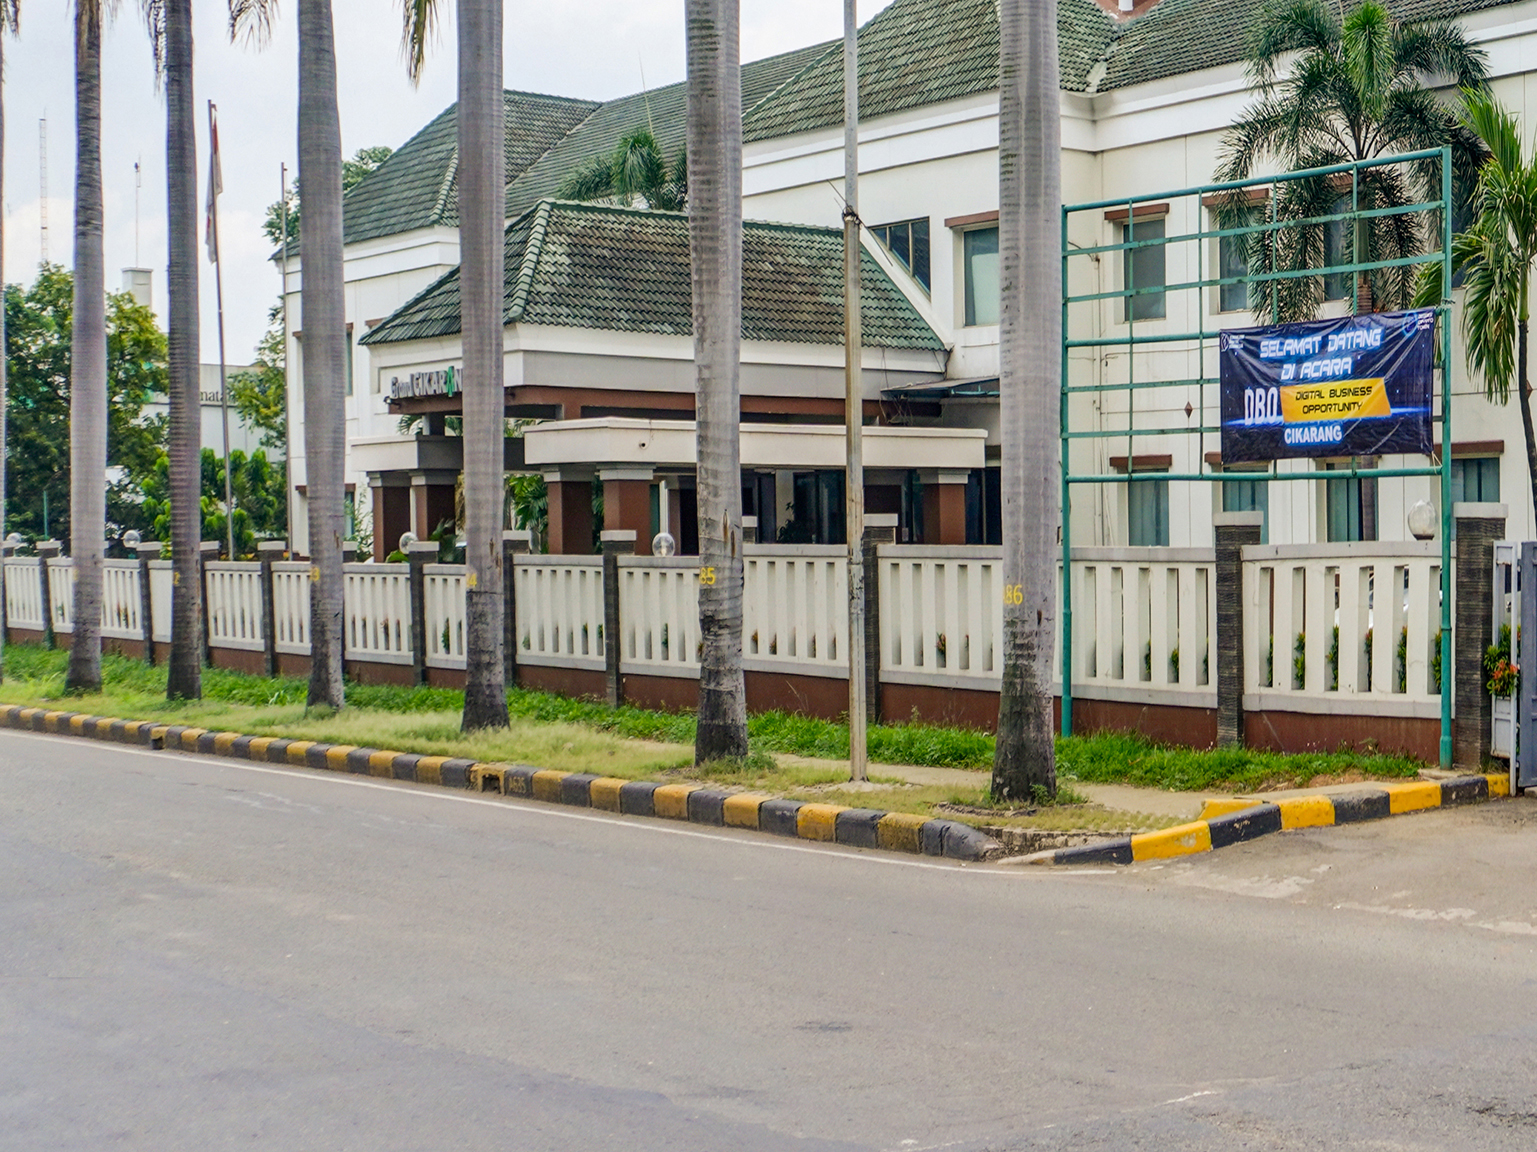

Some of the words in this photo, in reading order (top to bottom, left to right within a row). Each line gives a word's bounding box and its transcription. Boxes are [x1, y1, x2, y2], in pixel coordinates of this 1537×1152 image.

[1260, 336, 1322, 358] SELAMAT
[1328, 328, 1382, 352] DATANG
[1280, 363, 1296, 380] DI
[1300, 356, 1352, 379] ACARA
[413, 366, 463, 397] CIKARAN
[1295, 389, 1325, 401] DIGITAL
[1329, 386, 1373, 399] BUSINESS
[1244, 386, 1278, 425] DBO
[1302, 402, 1363, 414] OPPORTUNITY
[1284, 425, 1342, 444] CIKARANG
